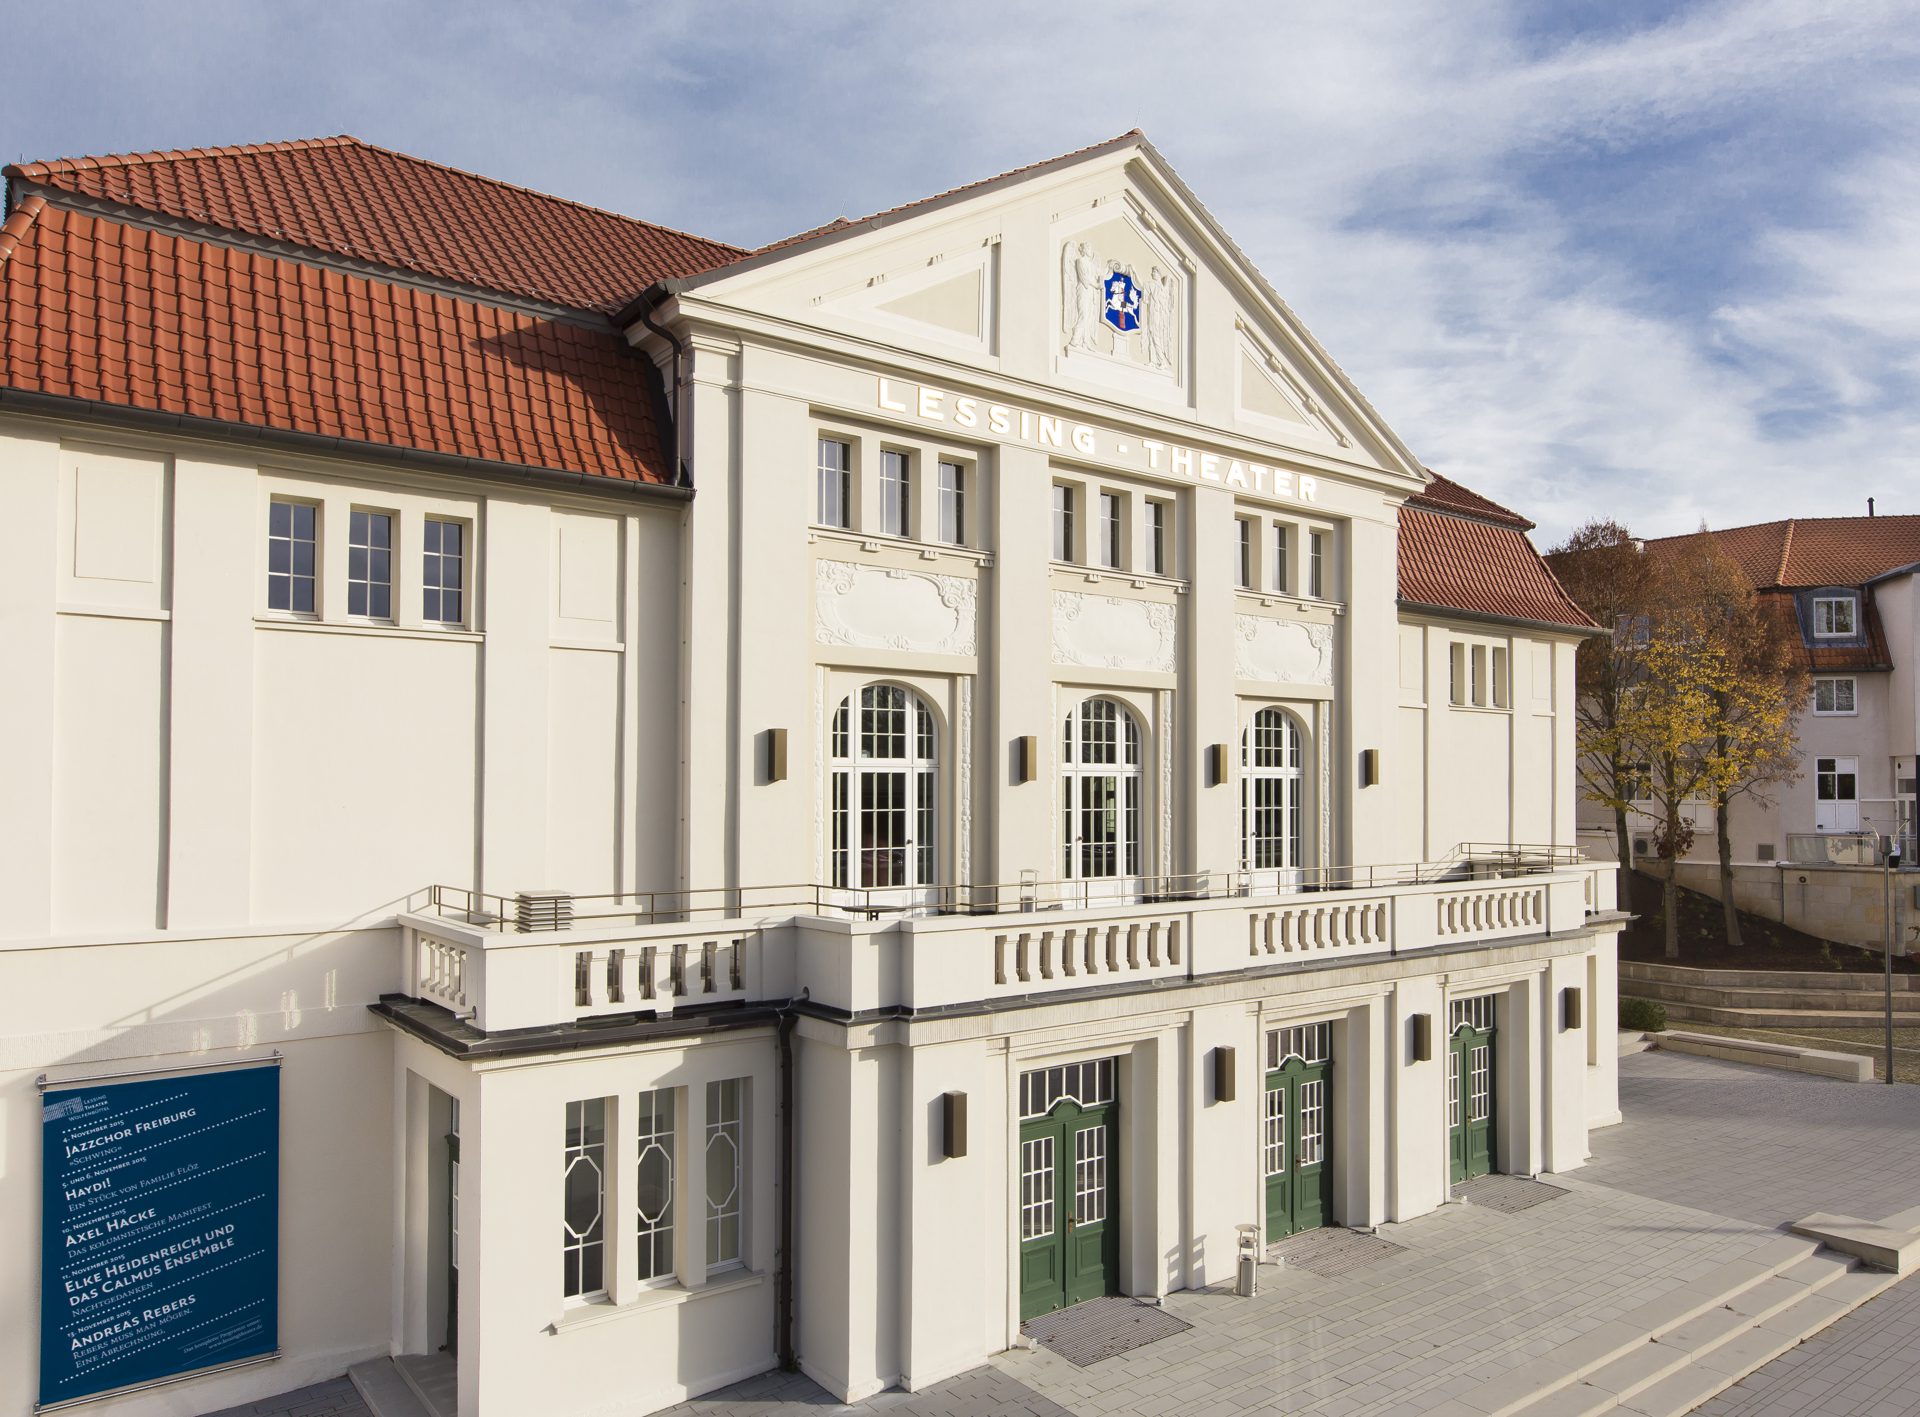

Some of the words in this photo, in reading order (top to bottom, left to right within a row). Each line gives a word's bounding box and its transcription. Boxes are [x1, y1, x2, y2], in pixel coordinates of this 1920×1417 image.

[878, 377, 1096, 455] LESSING
[1141, 439, 1318, 502] THEATER
[109, 1120, 125, 1128] 2015
[135, 1108, 196, 1134] FREIBURG
[132, 1156, 147, 1167] 2015
[106, 1208, 157, 1232] HACKE
[111, 1208, 127, 1217] 2015
[105, 1235, 201, 1278] HEIDENREICH
[205, 1223, 235, 1241] UND
[109, 1254, 125, 1263] 2015
[69, 1289, 99, 1306] DAS
[164, 1237, 235, 1271] ENSEMBLE
[71, 1316, 140, 1350] ANDREAS
[142, 1294, 196, 1321] REBERS
[115, 1310, 131, 1319] 2015
